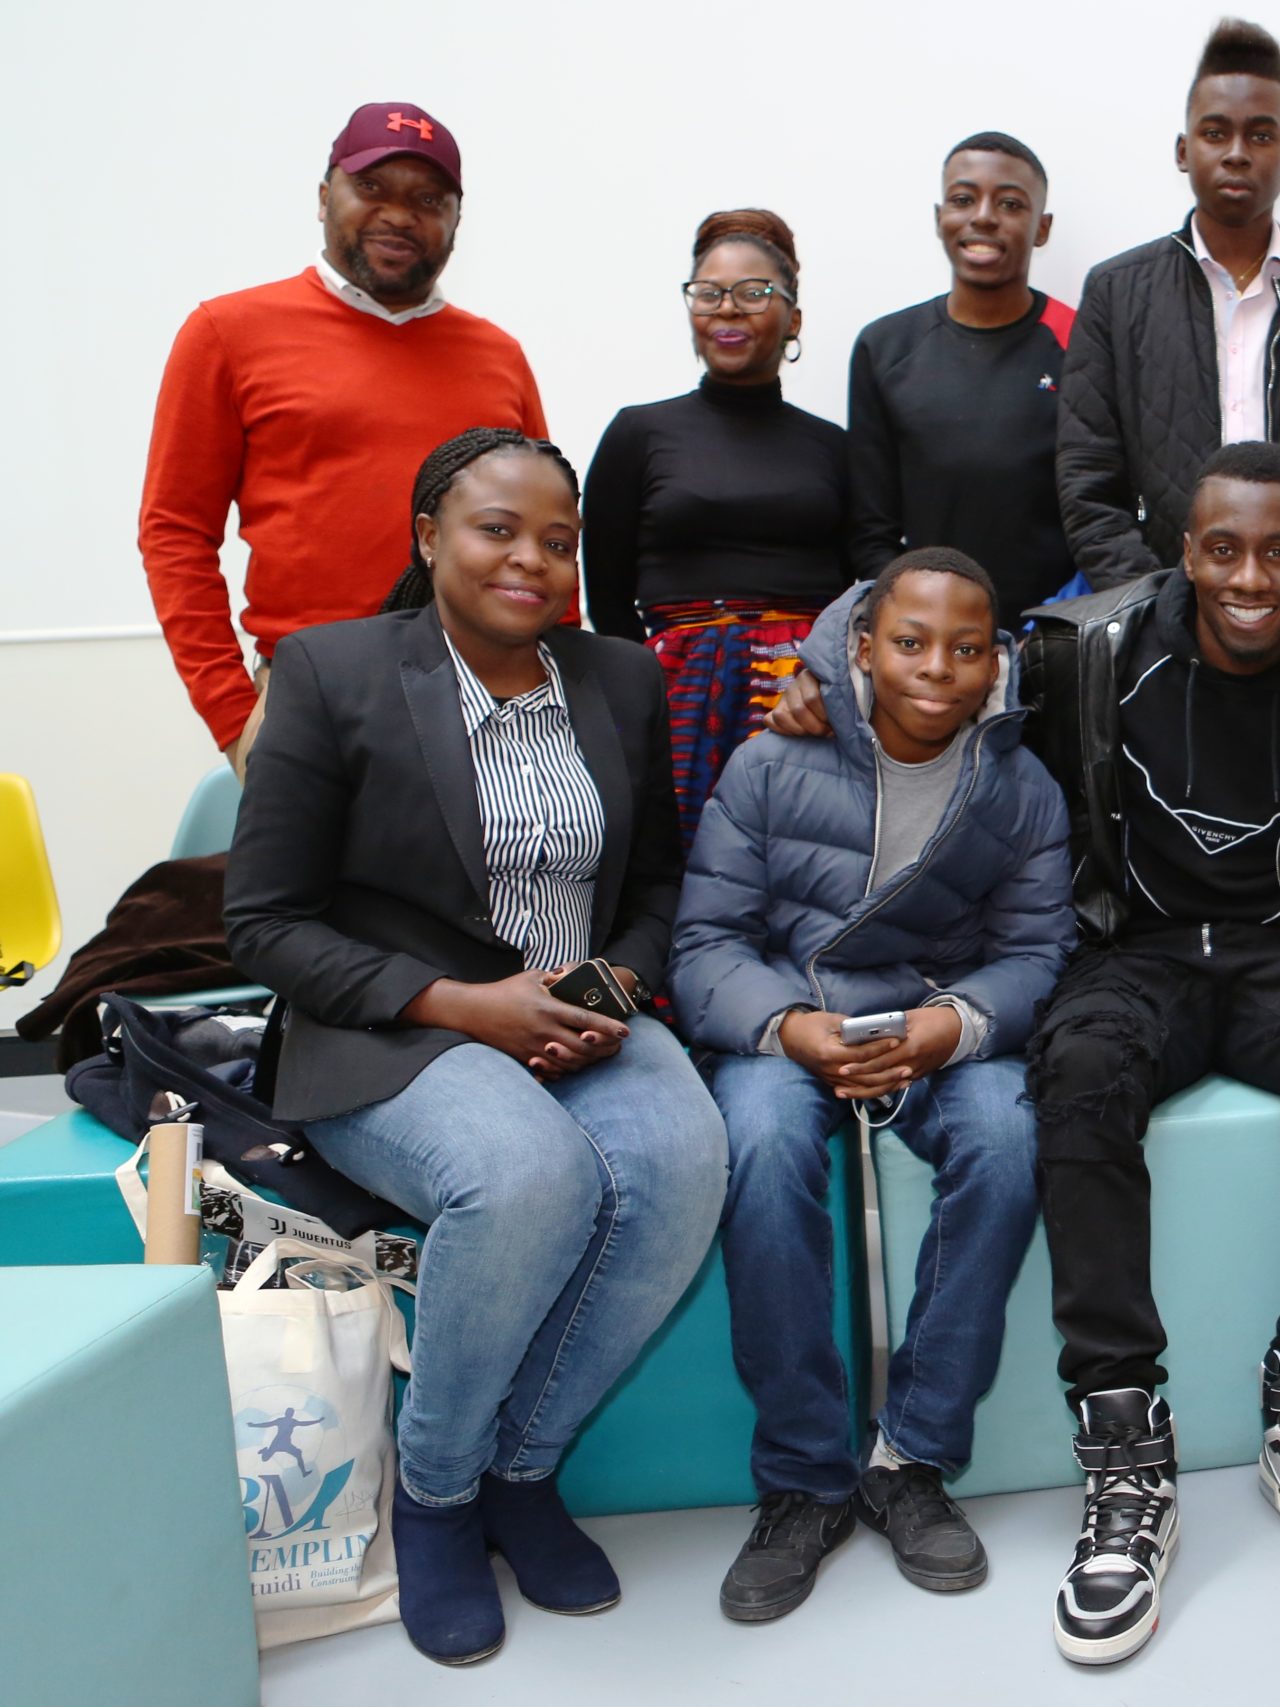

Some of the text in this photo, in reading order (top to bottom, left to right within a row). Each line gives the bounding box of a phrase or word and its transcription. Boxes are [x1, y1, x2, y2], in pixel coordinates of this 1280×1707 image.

[1191, 826, 1236, 841] GIVENCHY
[292, 1228, 352, 1250] JUVENTUS
[310, 1566, 349, 1580] Building
